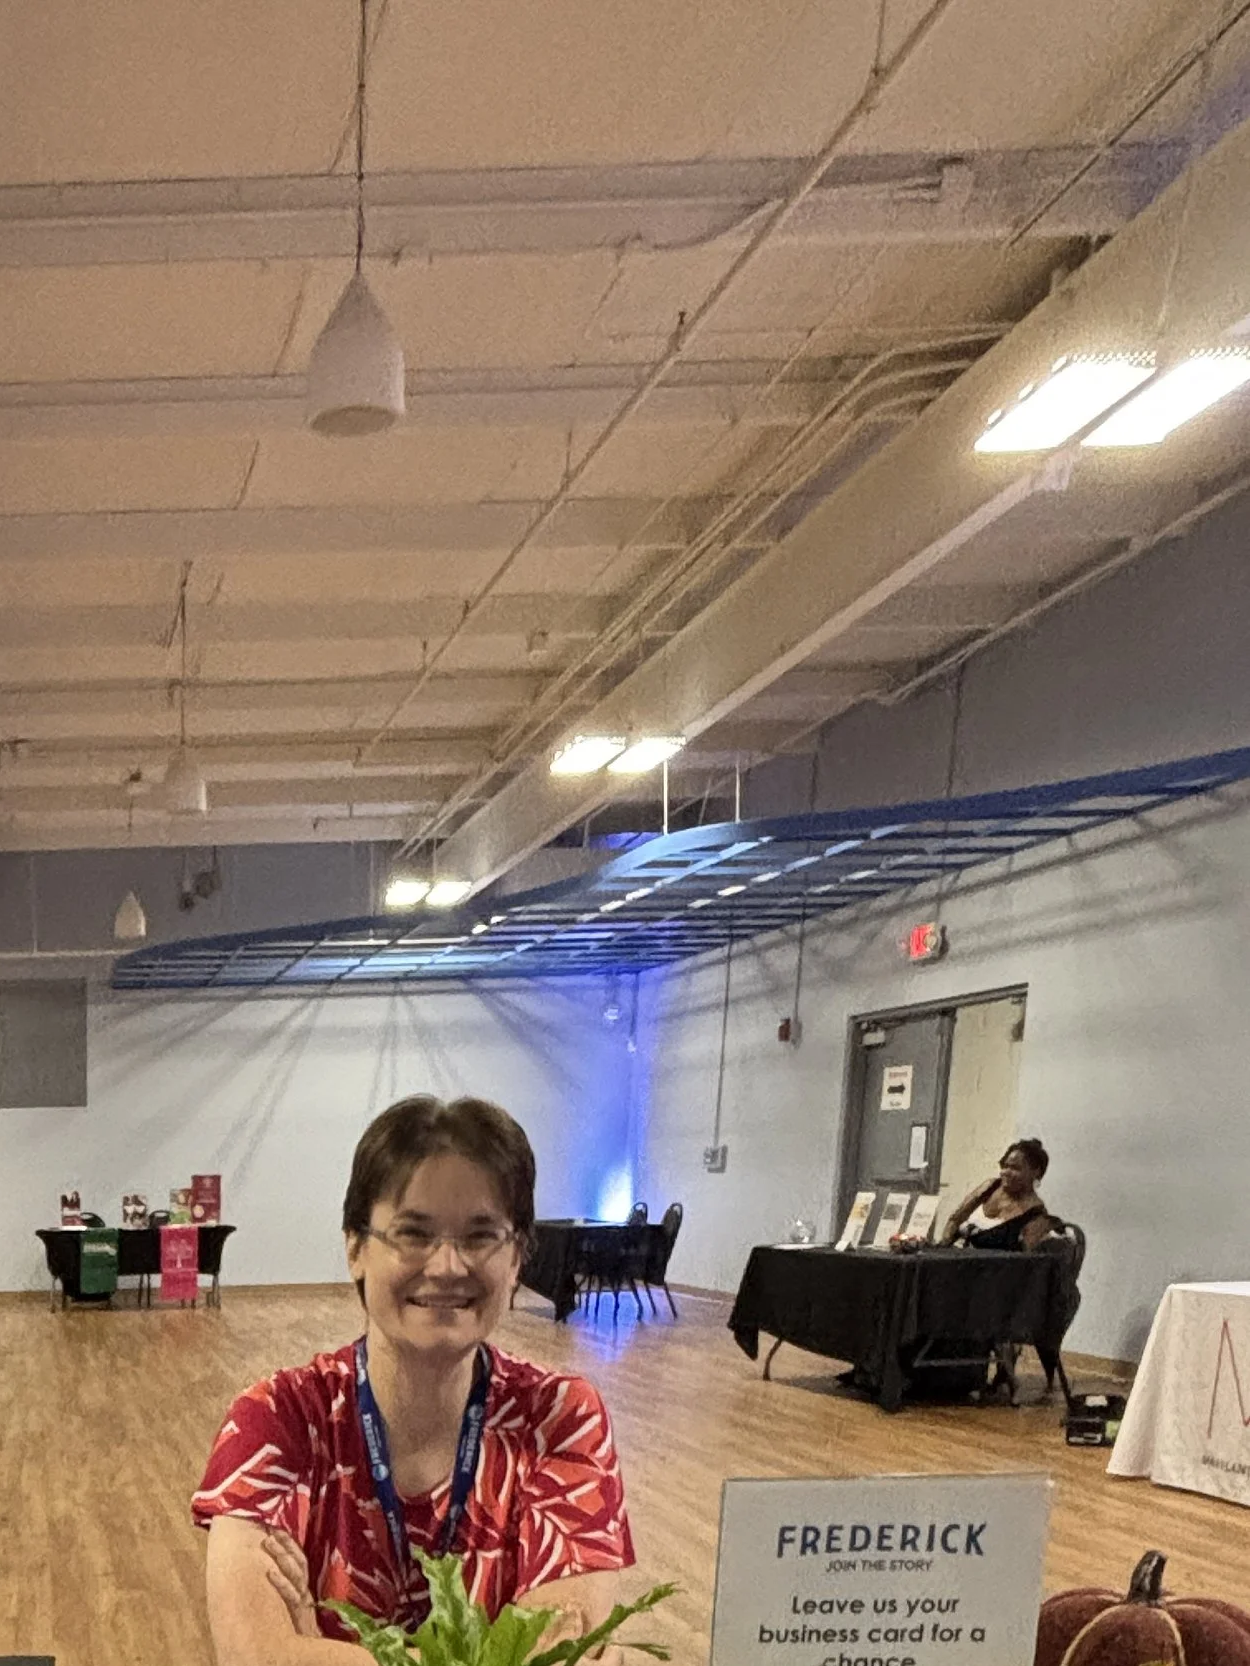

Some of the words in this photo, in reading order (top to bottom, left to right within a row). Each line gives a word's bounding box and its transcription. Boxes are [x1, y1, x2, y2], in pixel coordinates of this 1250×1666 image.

[776, 1522, 987, 1558] FREDERICK
[825, 1560, 856, 1573] JOIN
[861, 1559, 886, 1572] THE
[889, 1559, 934, 1572] STORY
[791, 1596, 865, 1615] Leave
[873, 1600, 897, 1614] us
[906, 1598, 960, 1618] your
[758, 1624, 859, 1644] business
[867, 1622, 924, 1643] card
[931, 1623, 962, 1643] for
[970, 1628, 986, 1643] a
